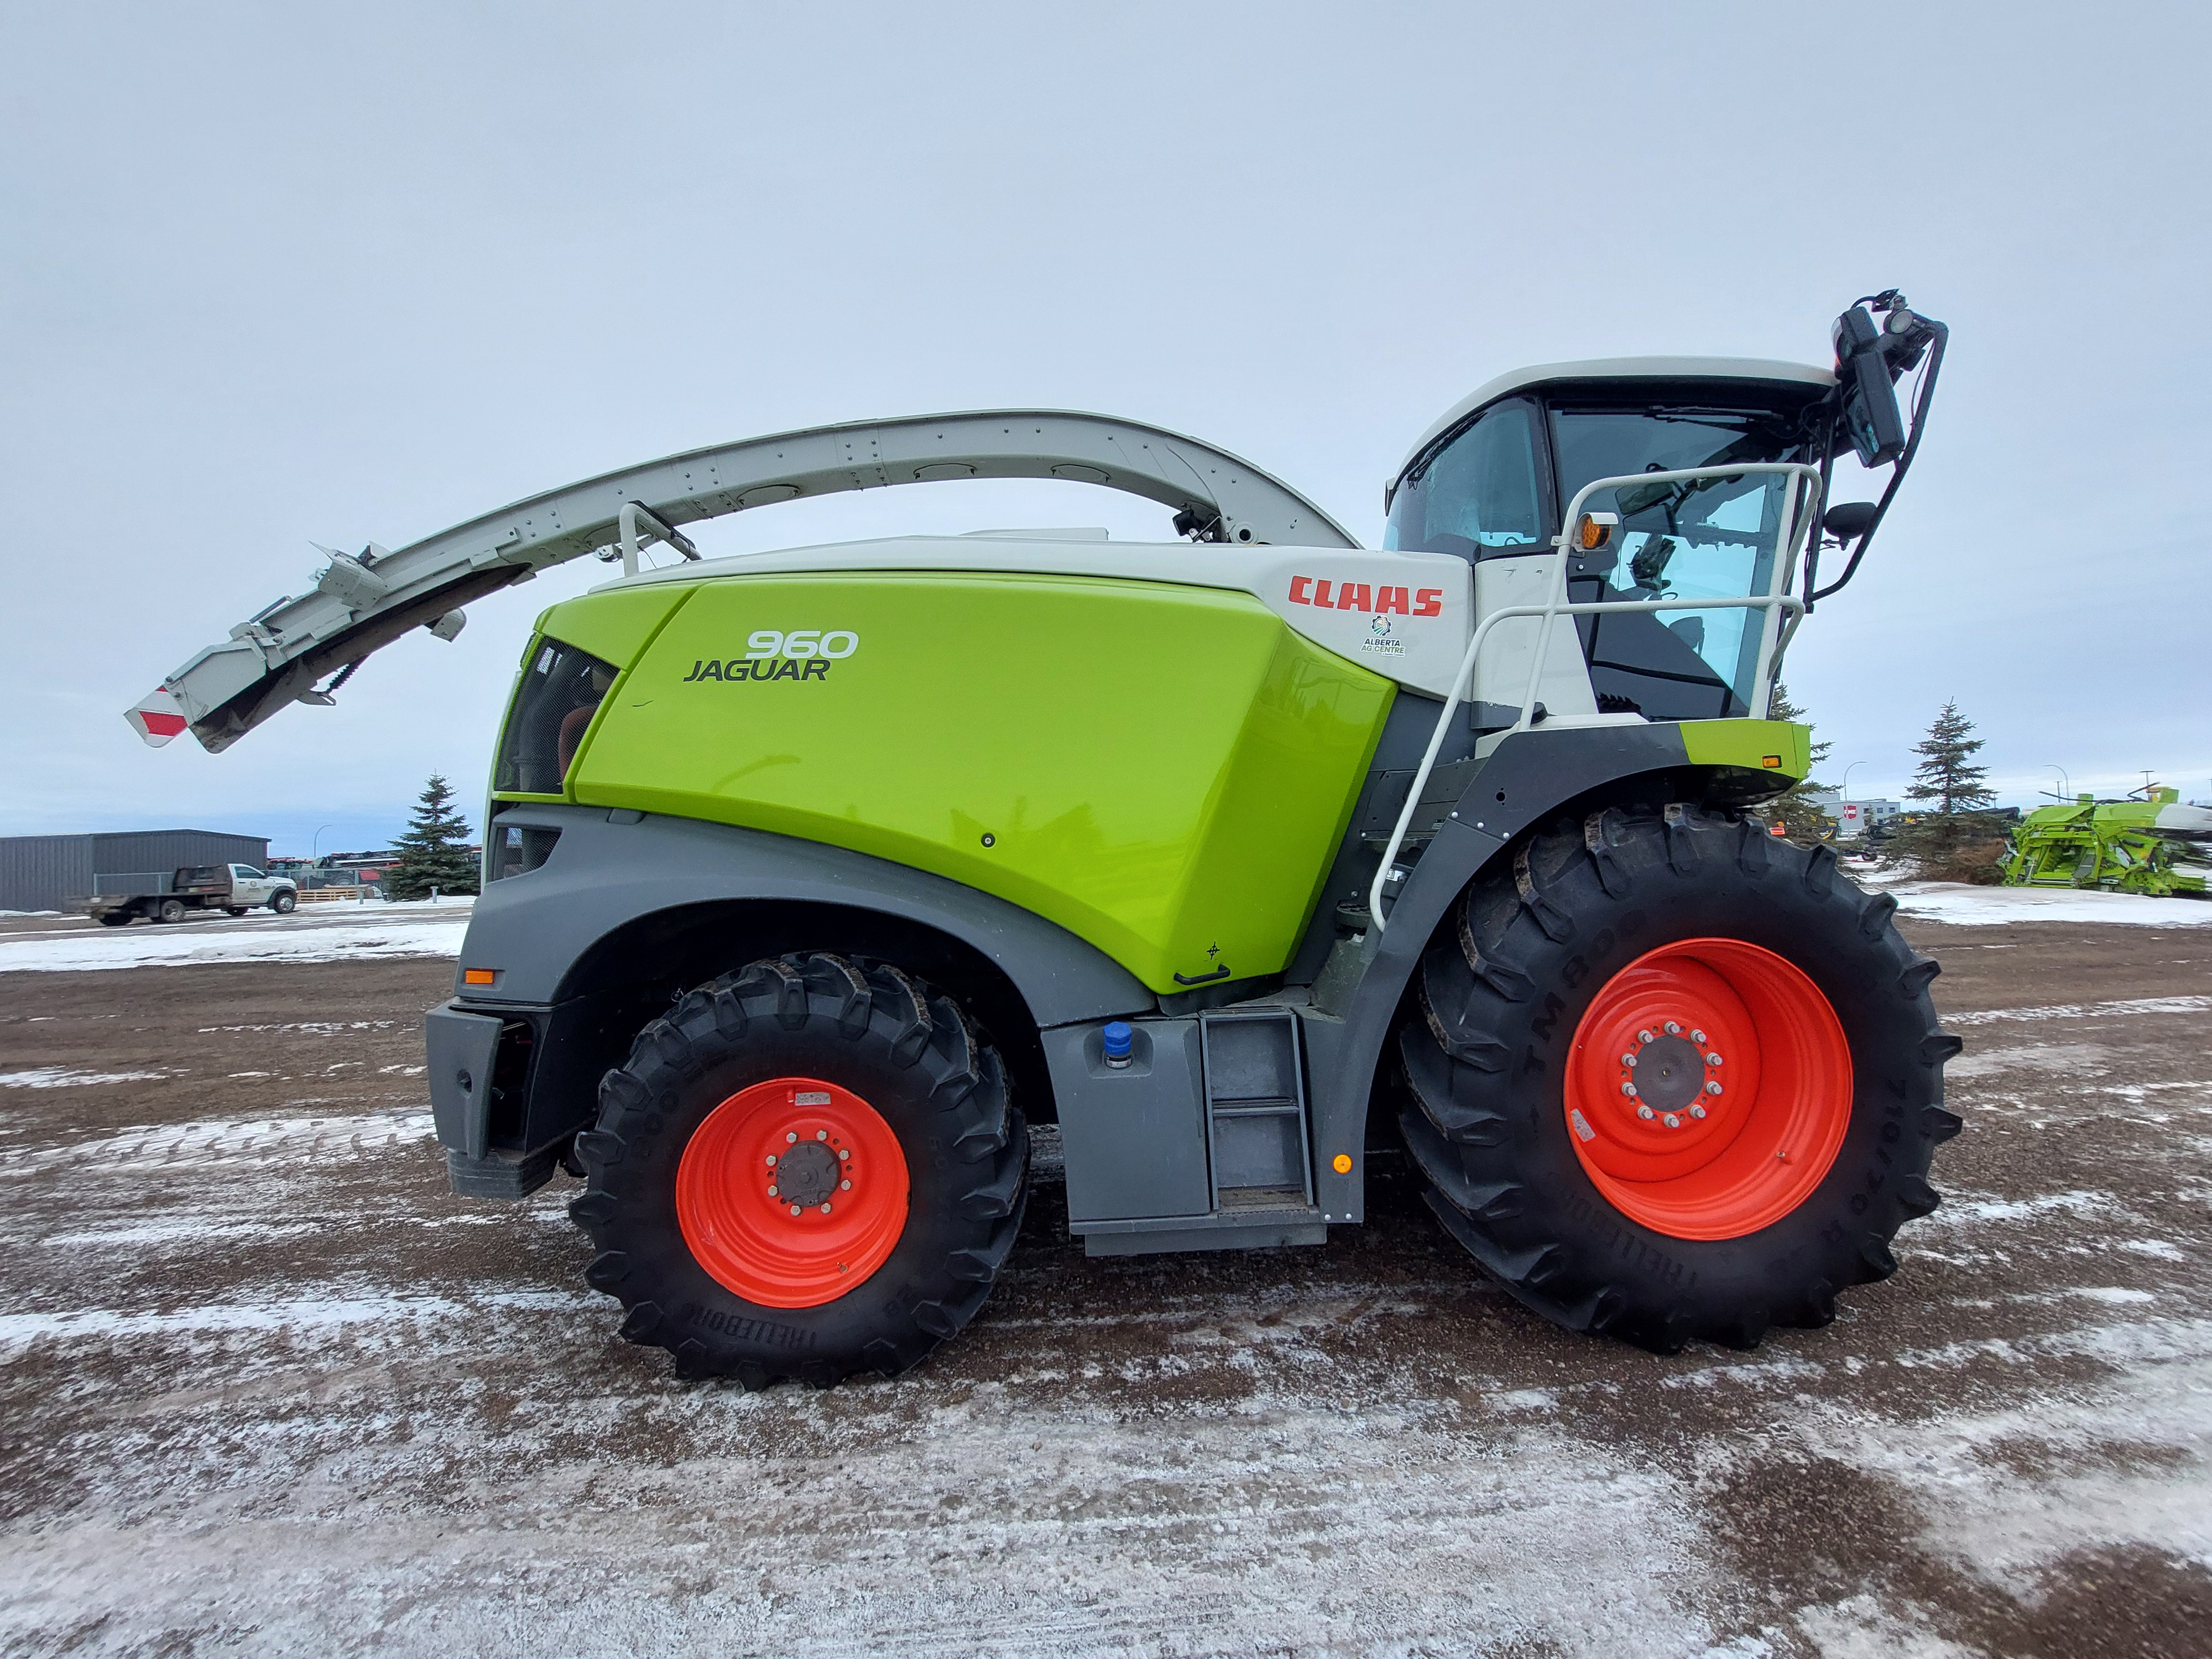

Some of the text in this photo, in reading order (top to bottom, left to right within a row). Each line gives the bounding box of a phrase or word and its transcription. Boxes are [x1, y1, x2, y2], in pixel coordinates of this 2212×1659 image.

[1288, 575, 1443, 617] CLAAS
[745, 630, 859, 659] 960
[1364, 638, 1400, 646] ALBERTA
[683, 659, 831, 682] JAGUAR
